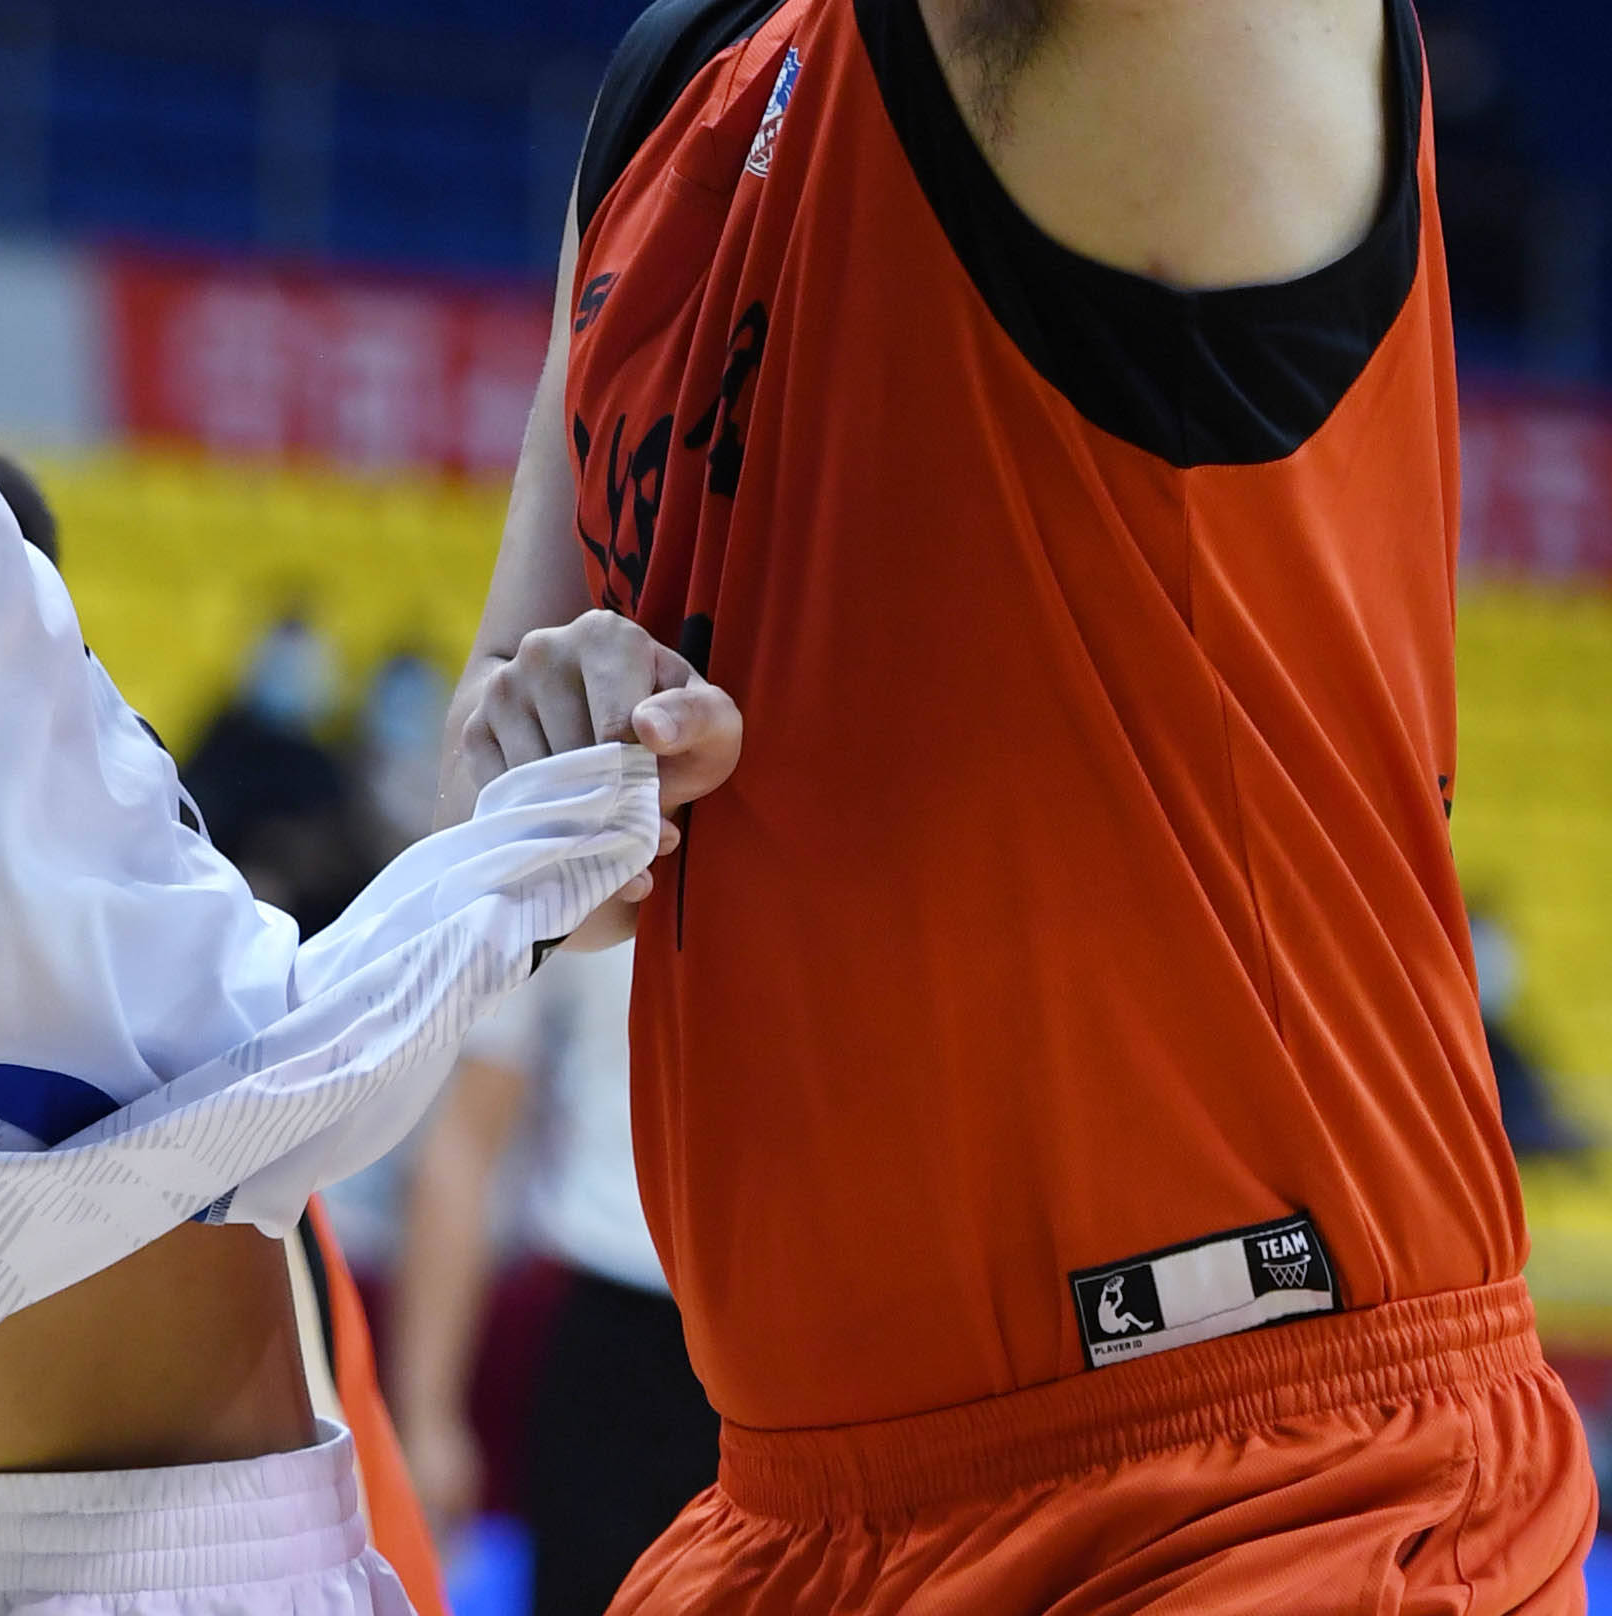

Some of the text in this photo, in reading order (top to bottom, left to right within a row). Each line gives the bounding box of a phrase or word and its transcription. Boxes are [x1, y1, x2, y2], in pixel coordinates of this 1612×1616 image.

[1257, 1230, 1310, 1260] TEAM
[1094, 1339, 1143, 1355] PLAYER ID
